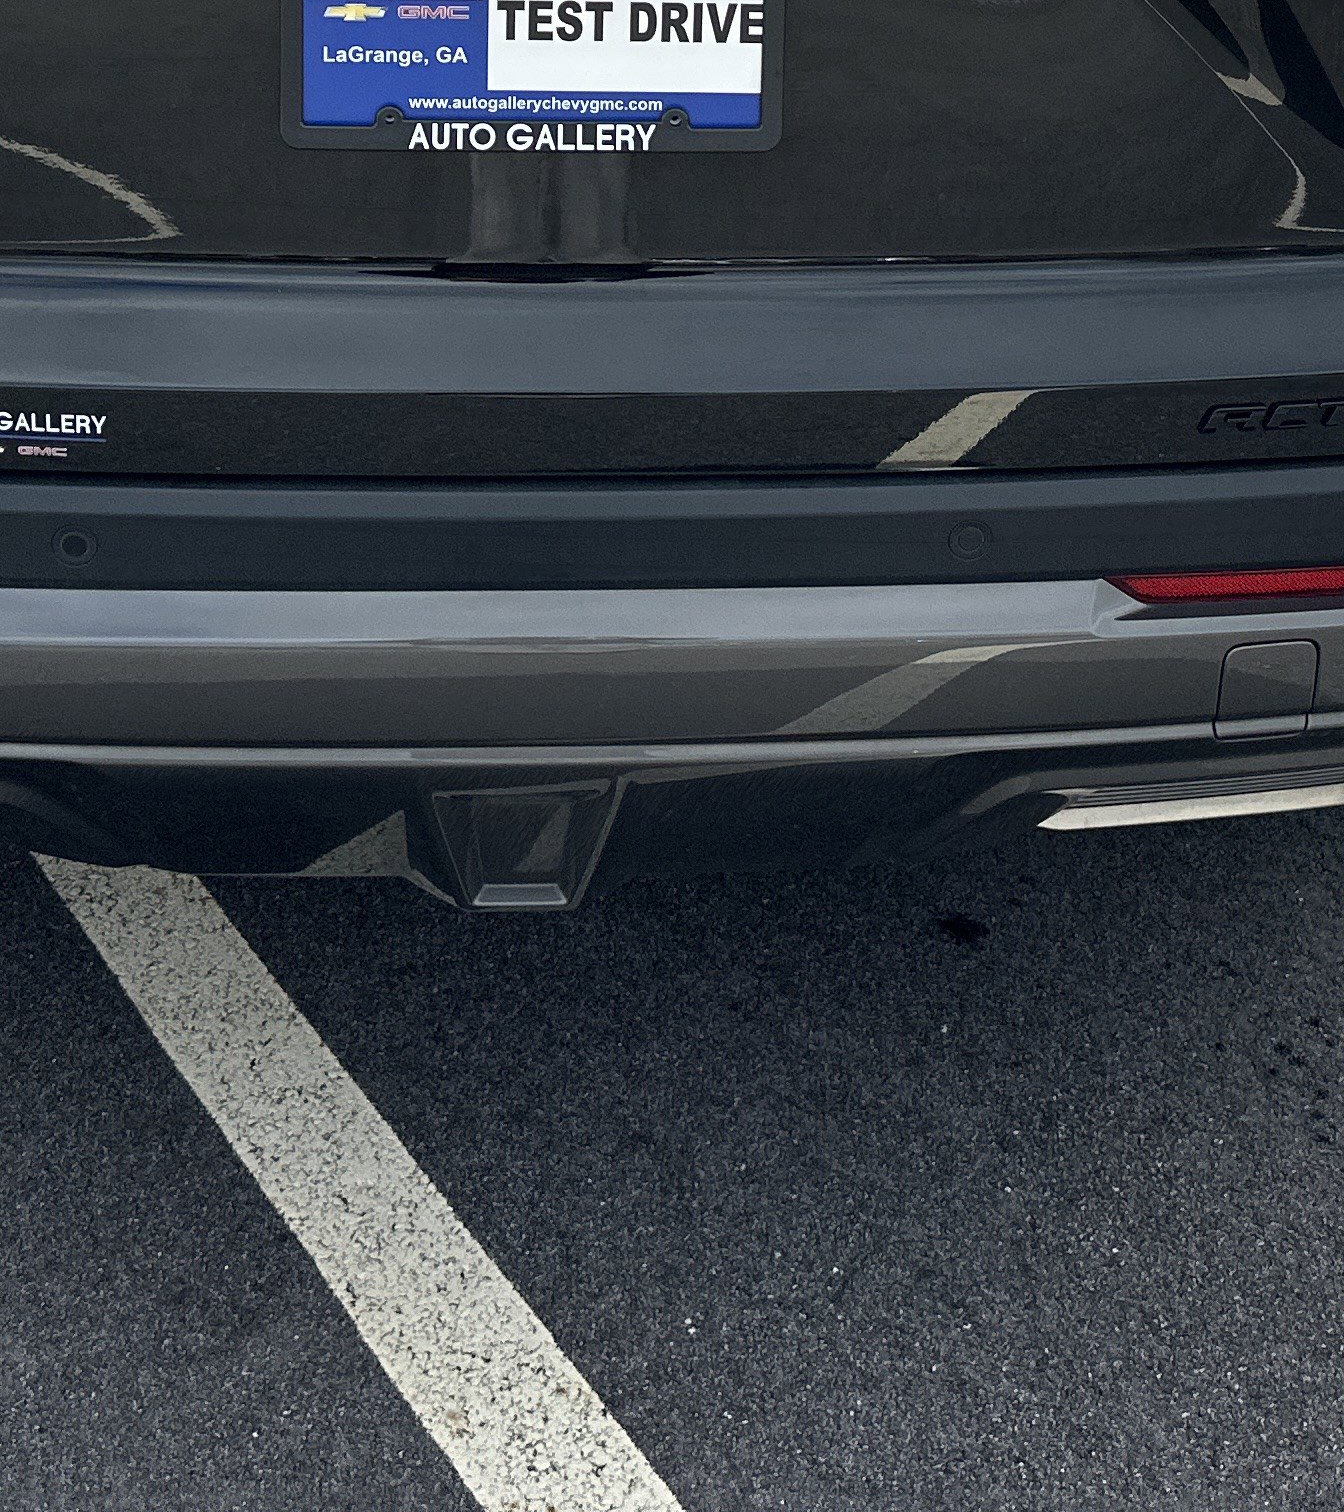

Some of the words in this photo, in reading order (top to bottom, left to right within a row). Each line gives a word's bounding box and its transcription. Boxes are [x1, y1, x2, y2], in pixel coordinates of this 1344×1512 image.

[397, 5, 470, 20] GMC
[497, 0, 613, 42] TEST
[629, 1, 763, 44] DRIVE
[323, 45, 429, 67] LaGrange,
[436, 46, 468, 64] GA
[408, 95, 663, 113] www.autogallerychevygmc.com
[408, 122, 497, 151] AUTO
[506, 123, 657, 151] GALLERY
[17, 445, 68, 458] GMC
